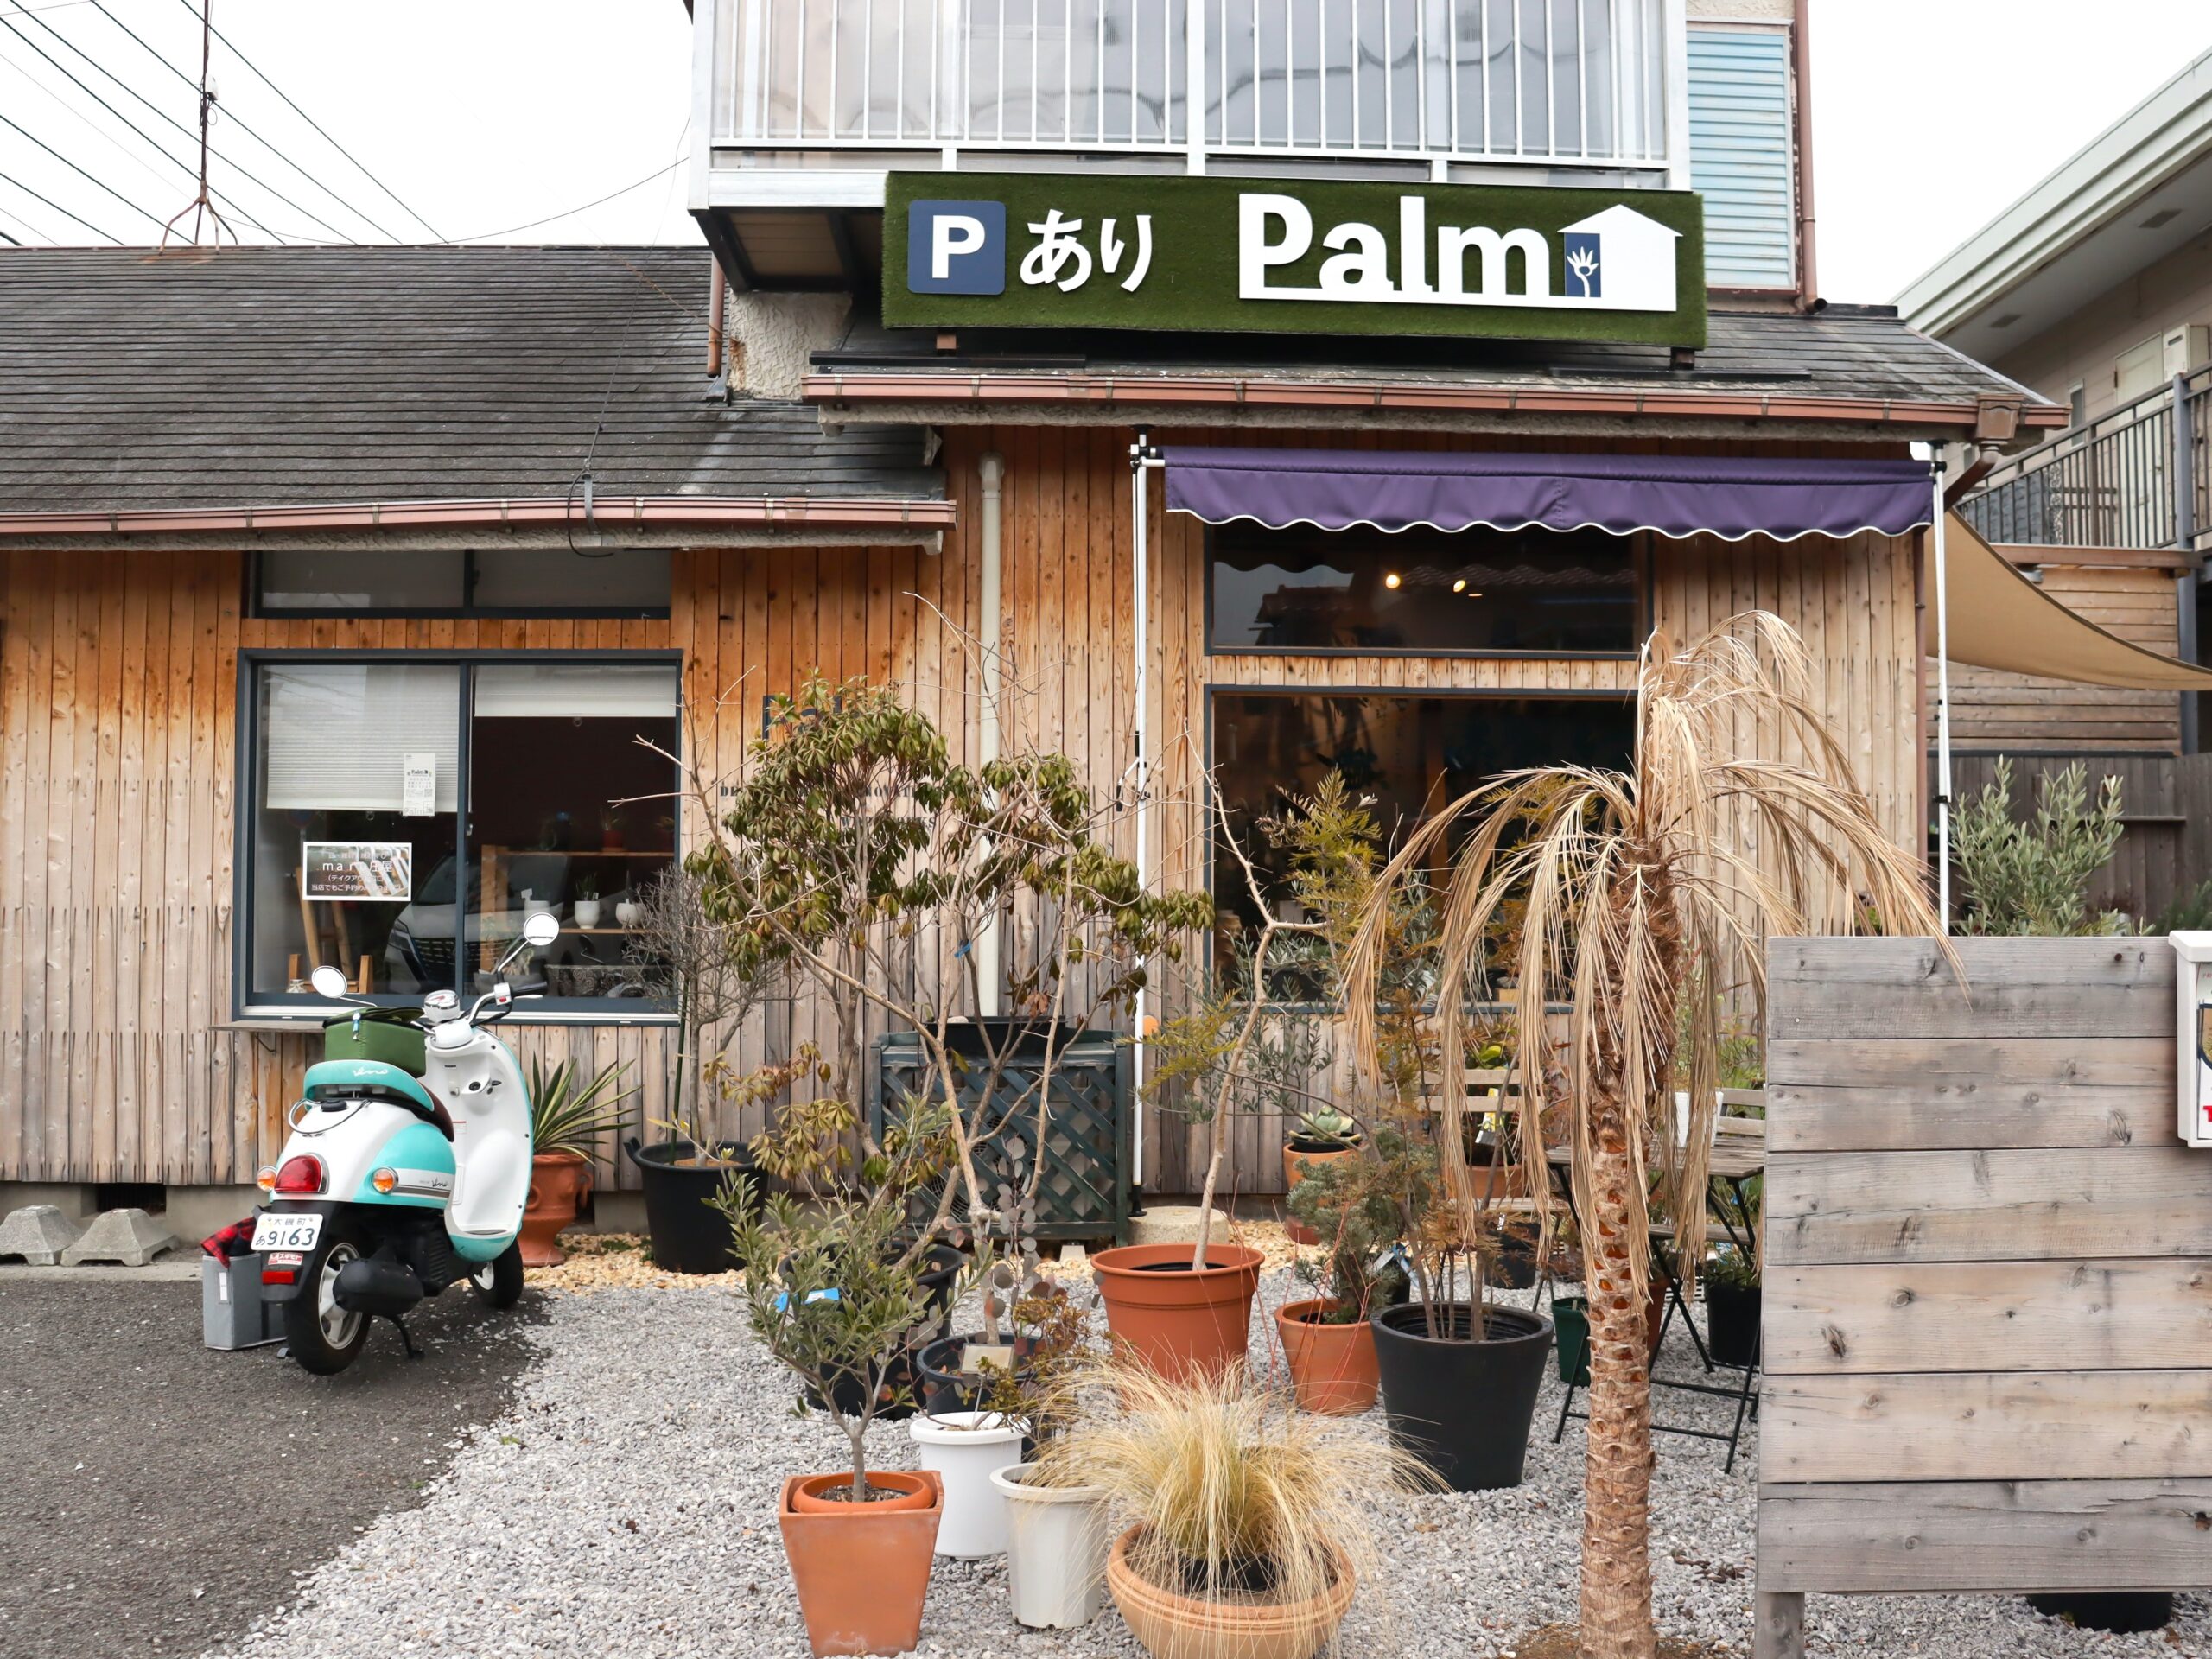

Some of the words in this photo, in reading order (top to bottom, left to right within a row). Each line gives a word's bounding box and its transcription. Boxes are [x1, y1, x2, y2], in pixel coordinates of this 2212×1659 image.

[931, 214, 986, 280] P
[1019, 208, 1154, 293] あり
[1238, 193, 1550, 299] Palm
[266, 1227, 315, 1246] 9163
[273, 1217, 307, 1226] 大磯町
